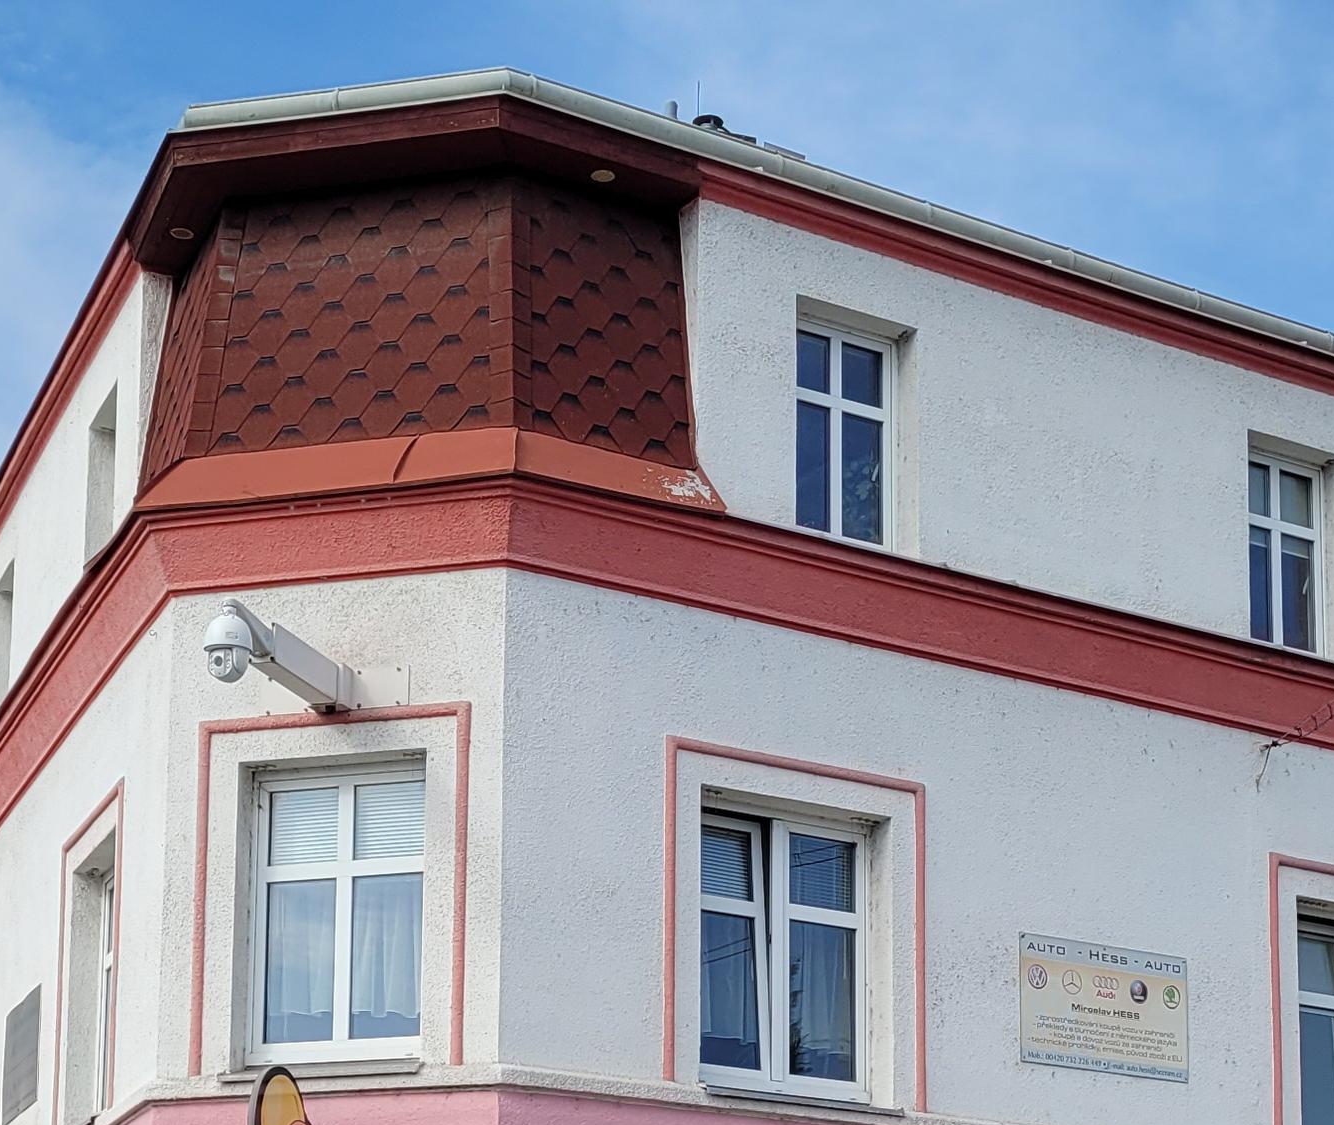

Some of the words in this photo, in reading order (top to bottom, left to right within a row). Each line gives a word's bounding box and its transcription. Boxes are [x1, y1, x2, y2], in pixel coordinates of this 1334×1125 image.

[1027, 942, 1066, 955] AUTO
[1089, 949, 1128, 965] HESS
[1145, 961, 1181, 974] AUTO
[1071, 1003, 1111, 1016] Miroslav
[1113, 1009, 1140, 1020] HESS
